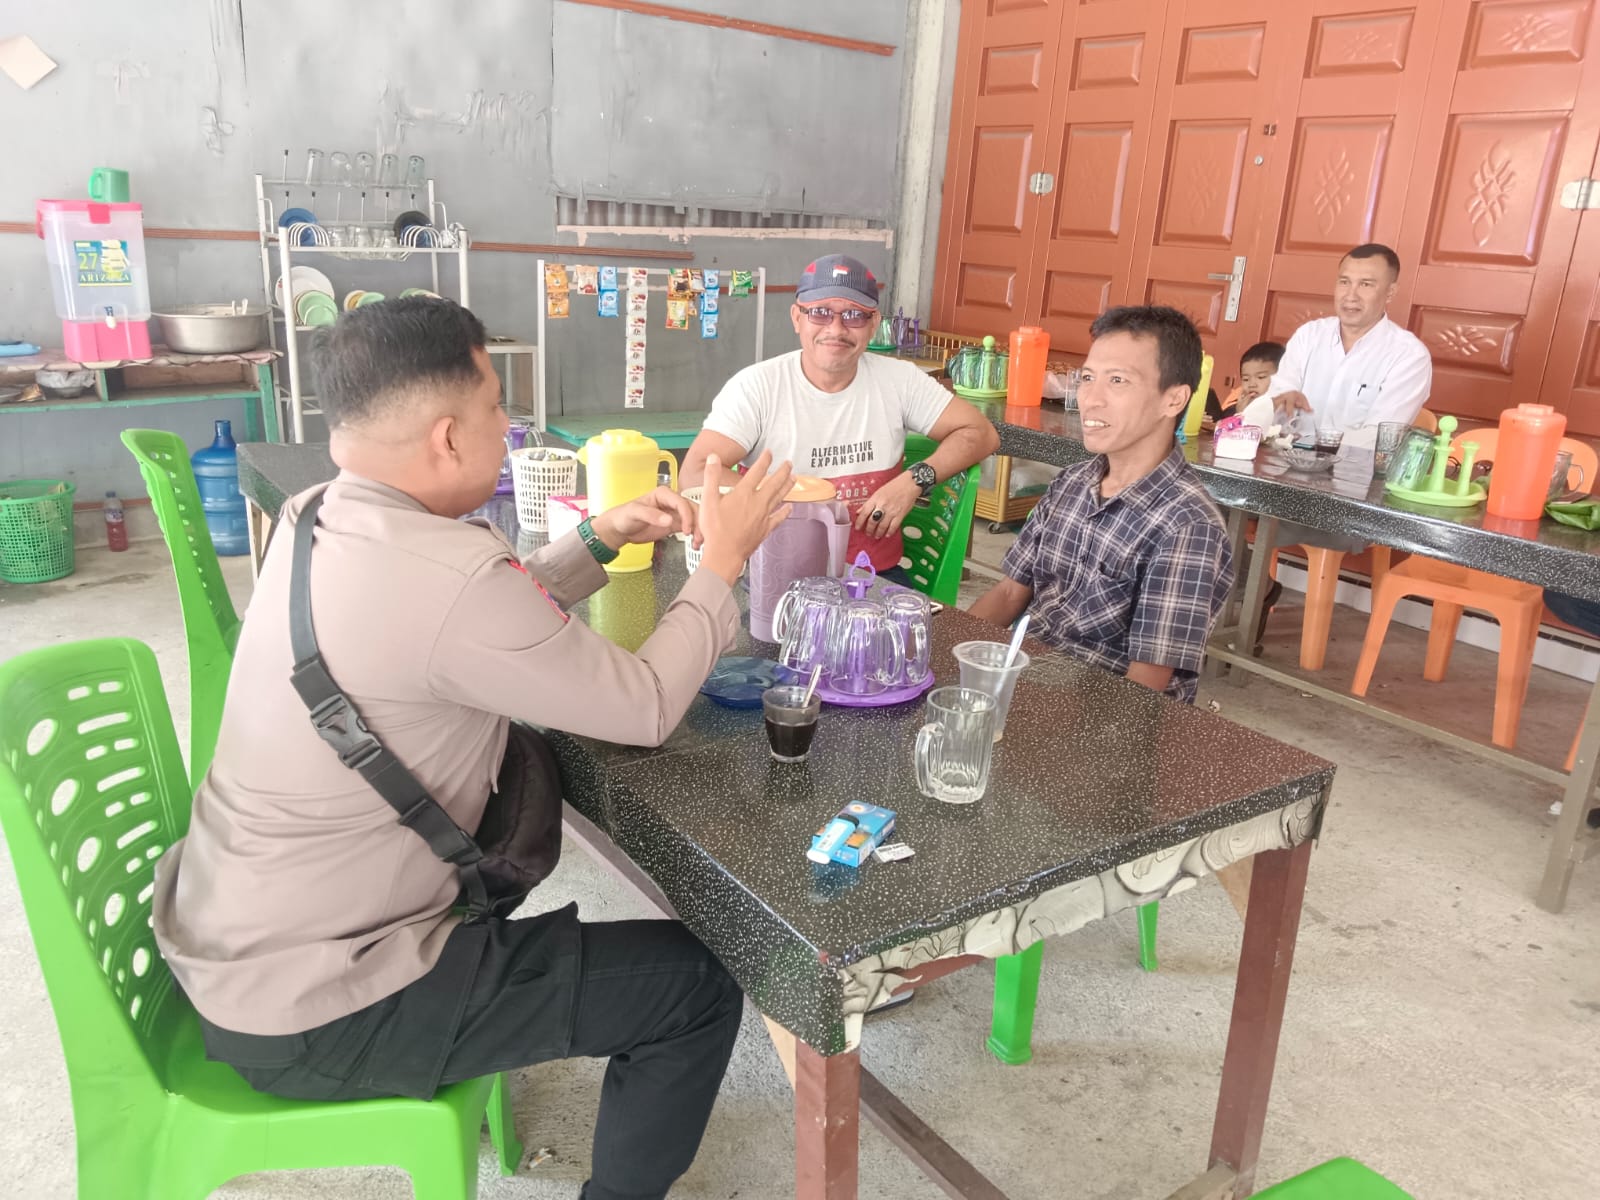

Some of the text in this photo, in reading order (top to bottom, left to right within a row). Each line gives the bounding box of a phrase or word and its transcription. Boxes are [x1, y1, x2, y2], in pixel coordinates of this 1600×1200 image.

[78, 253, 97, 269] 27
[80, 273, 129, 281] ARIZA
[811, 441, 872, 457] ALTERNATIVE
[811, 452, 873, 467] EXPANSION
